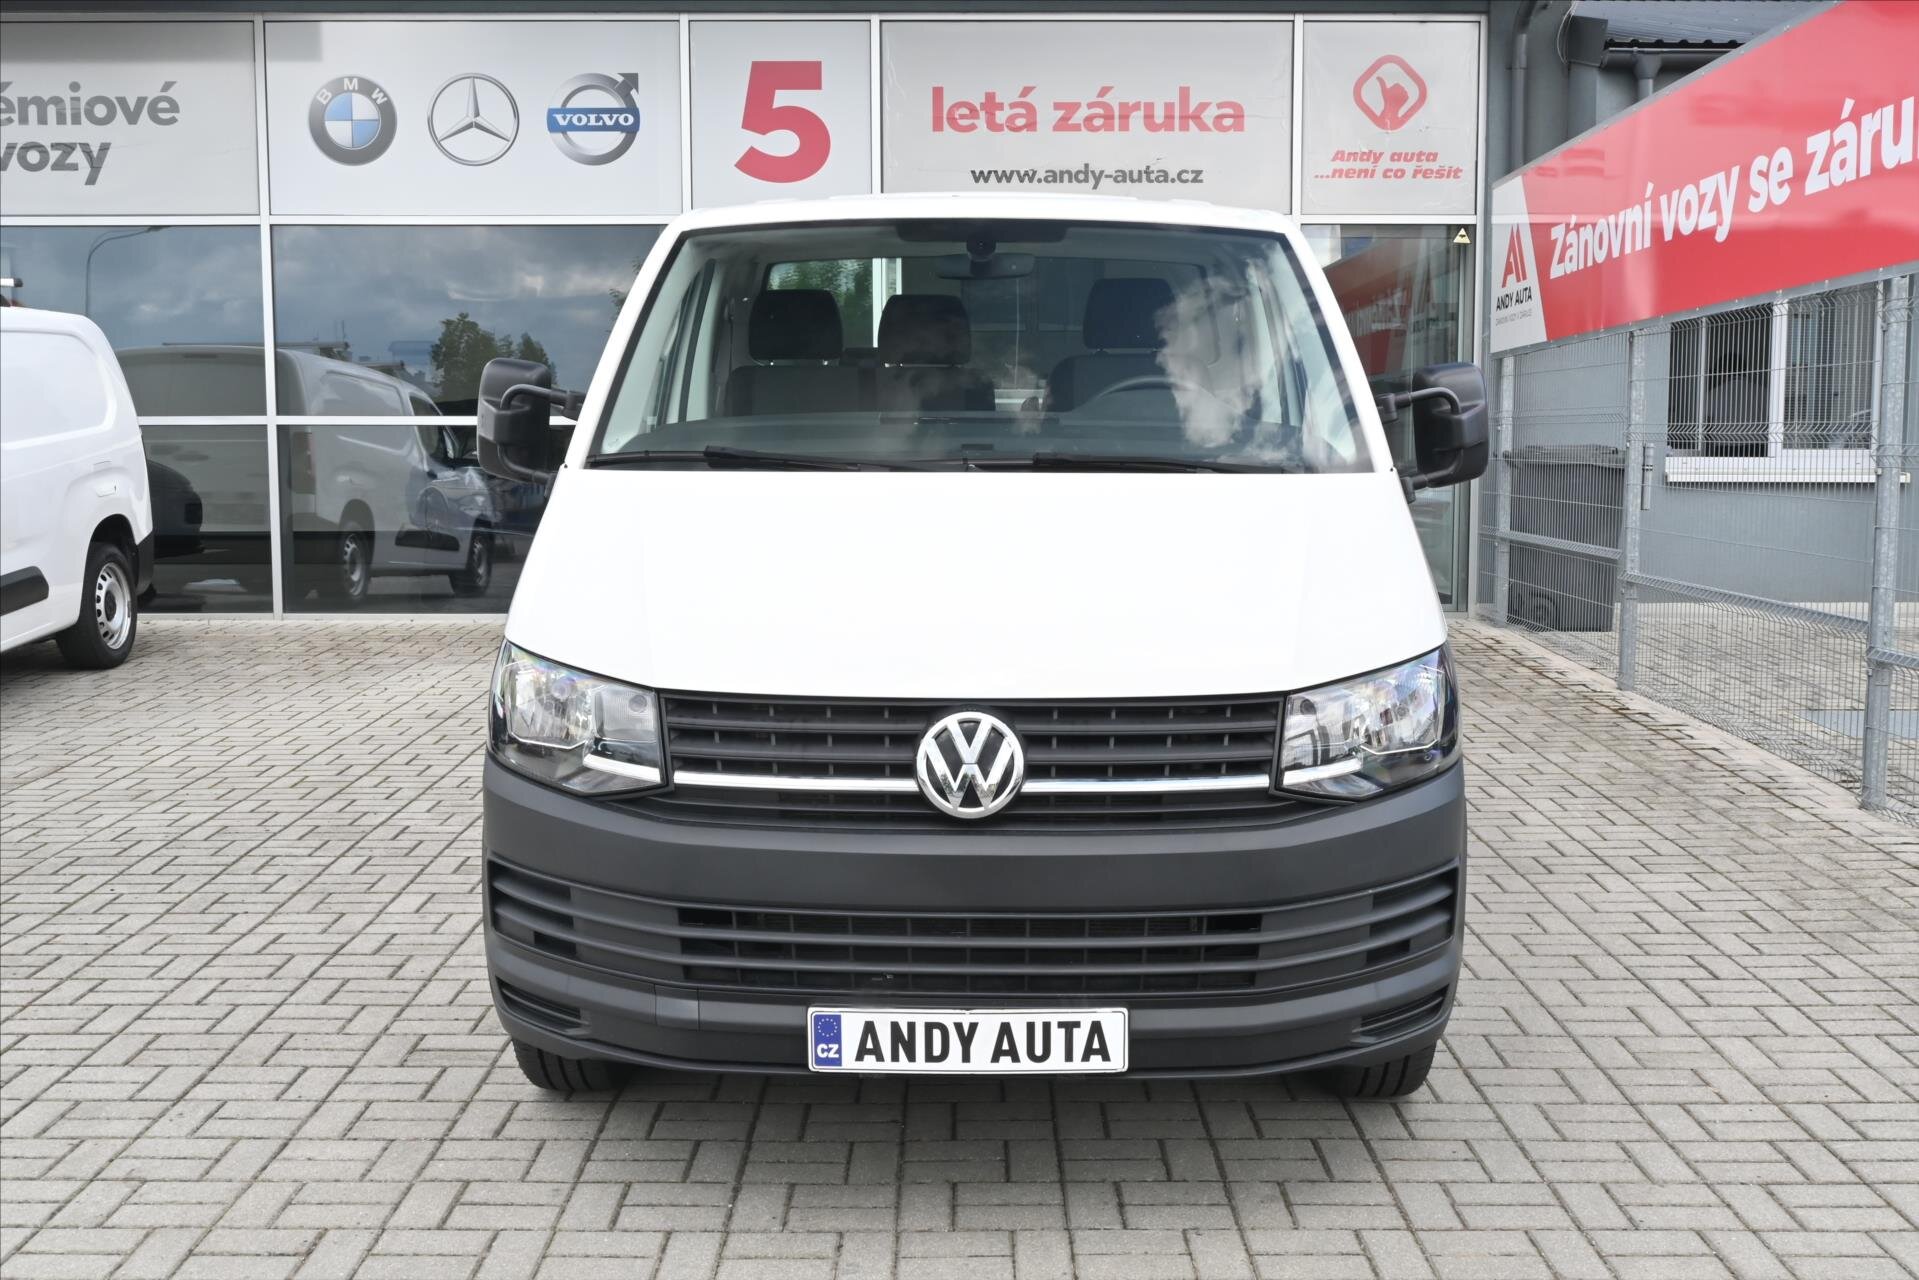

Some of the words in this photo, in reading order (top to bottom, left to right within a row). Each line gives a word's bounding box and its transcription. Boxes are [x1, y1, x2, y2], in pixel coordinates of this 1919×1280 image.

[316, 77, 388, 105] BMW
[552, 113, 635, 126] VOLVO
[734, 61, 831, 183] 5
[932, 86, 1037, 133] letá
[1052, 86, 1245, 133] záruka
[0, 141, 112, 186] vozy
[1331, 150, 1384, 164] Andy
[1390, 150, 1438, 163] auta
[970, 163, 1204, 190] www.andy-auta.cz
[1382, 168, 1406, 179] co
[1411, 165, 1463, 179] řešit
[1550, 182, 1654, 279] Zánovní
[1660, 165, 1740, 243] vozy
[1748, 147, 1793, 213] se
[1804, 95, 1919, 196] záru
[1496, 291, 1514, 312] ANDY
[1515, 286, 1532, 306] AUTA
[816, 1043, 840, 1059] CZ
[854, 1020, 979, 1063] ANDY
[990, 1020, 1112, 1063] AUTA
